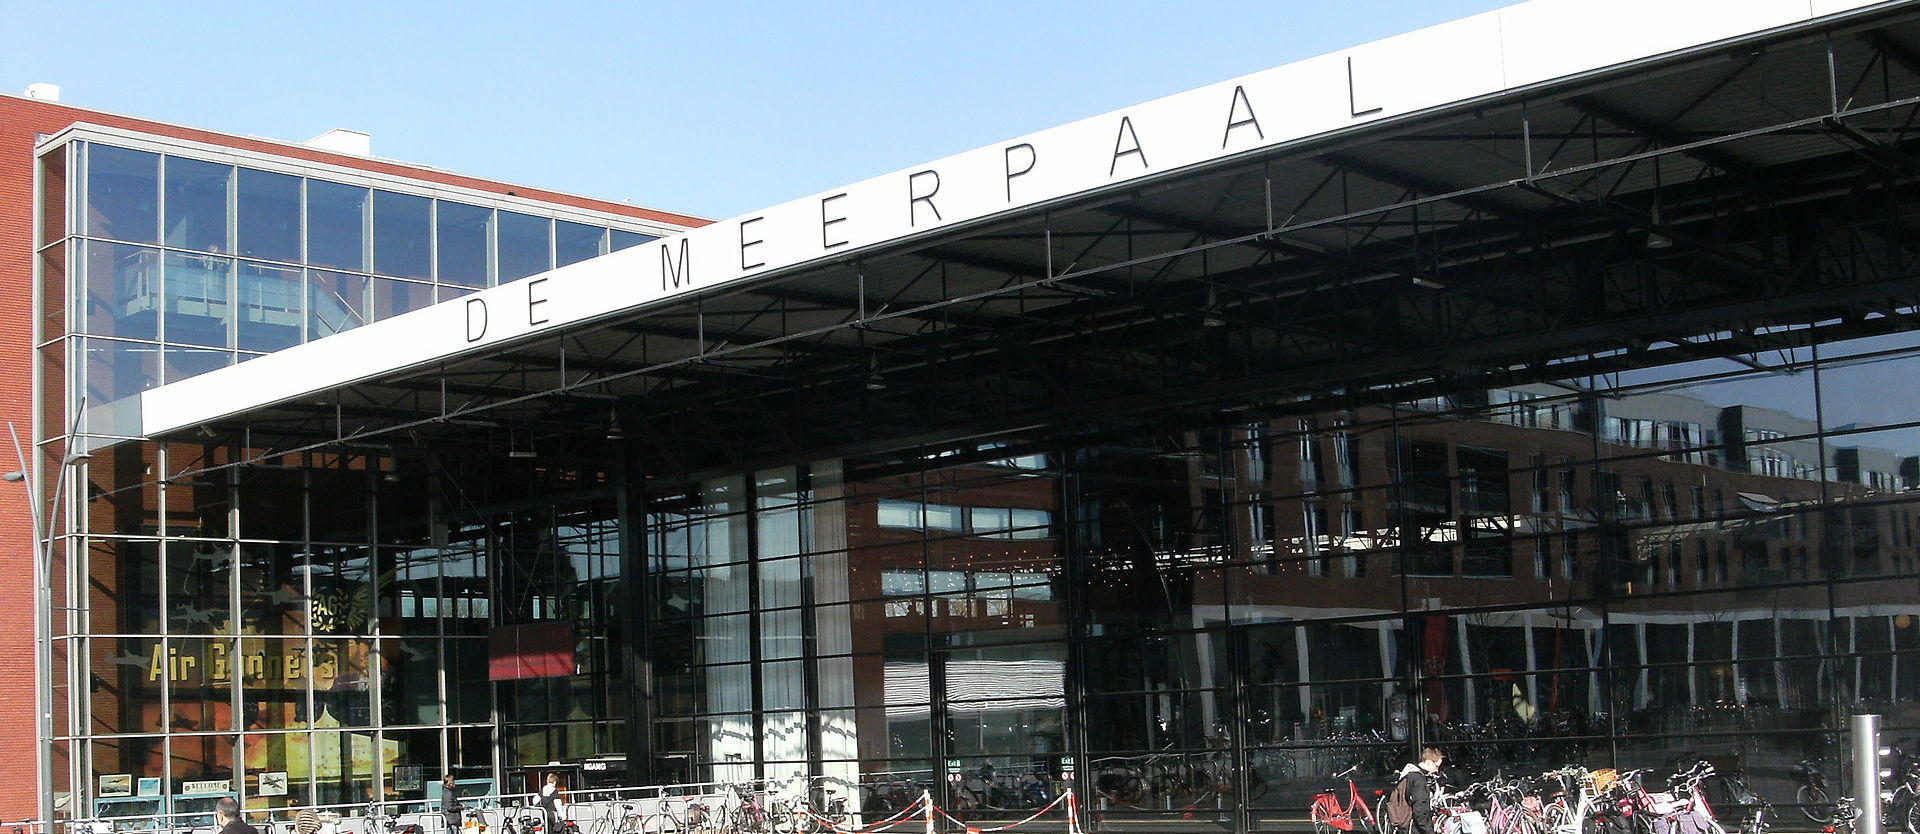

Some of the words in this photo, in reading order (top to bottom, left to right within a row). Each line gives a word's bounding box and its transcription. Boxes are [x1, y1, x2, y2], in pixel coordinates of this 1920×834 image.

[466, 278, 549, 343] DE
[661, 56, 1384, 292] MEERPAAL
[149, 643, 195, 681] Air
[210, 643, 336, 679] Gnnes
